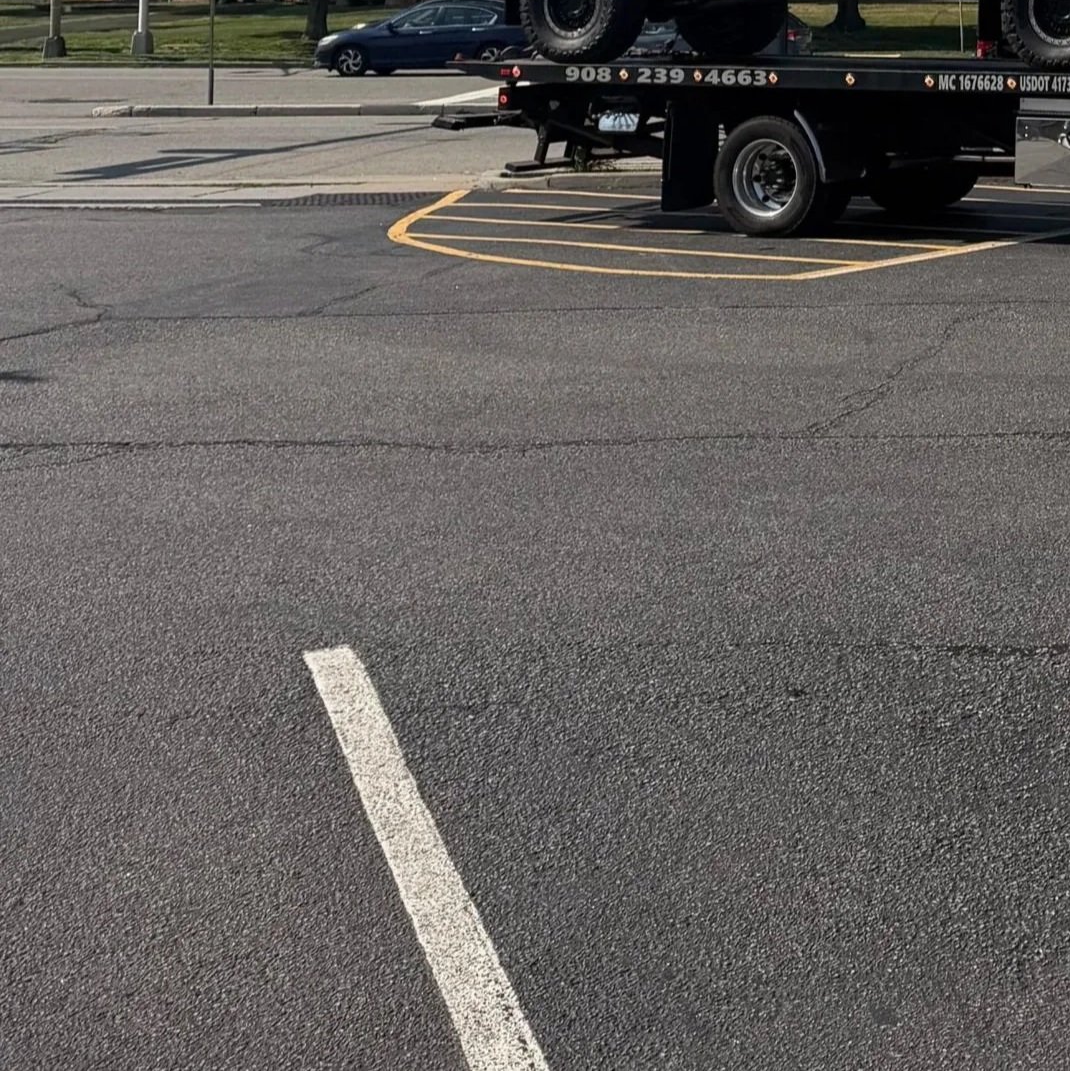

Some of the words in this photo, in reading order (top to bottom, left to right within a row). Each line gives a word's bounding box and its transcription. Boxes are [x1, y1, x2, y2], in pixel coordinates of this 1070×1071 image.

[565, 66, 612, 82] 908
[637, 68, 685, 84] 239
[704, 70, 767, 86] 4663
[938, 74, 956, 91] MC
[959, 74, 1004, 91] 1676628
[1019, 75, 1050, 92] USDOT
